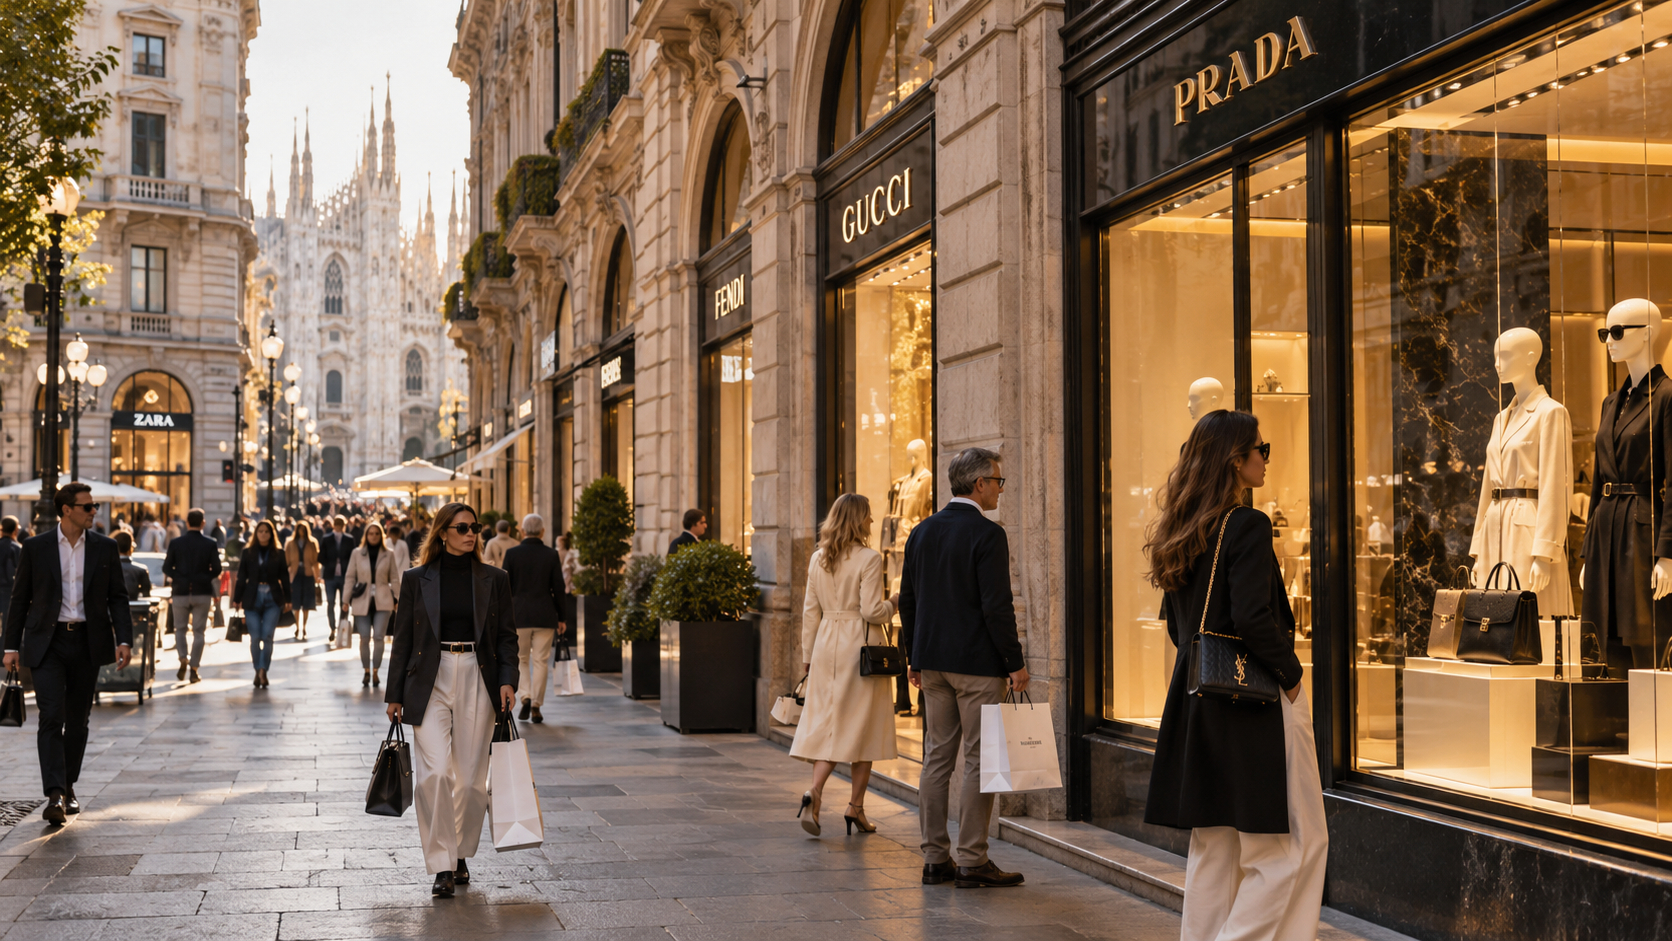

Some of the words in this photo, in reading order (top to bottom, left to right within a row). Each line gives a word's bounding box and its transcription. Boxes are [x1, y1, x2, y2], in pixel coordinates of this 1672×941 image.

[1173, 16, 1319, 126] PRADA
[841, 167, 913, 243] GUCCI
[714, 273, 745, 320] FENDI
[133, 413, 175, 427] ZARA
